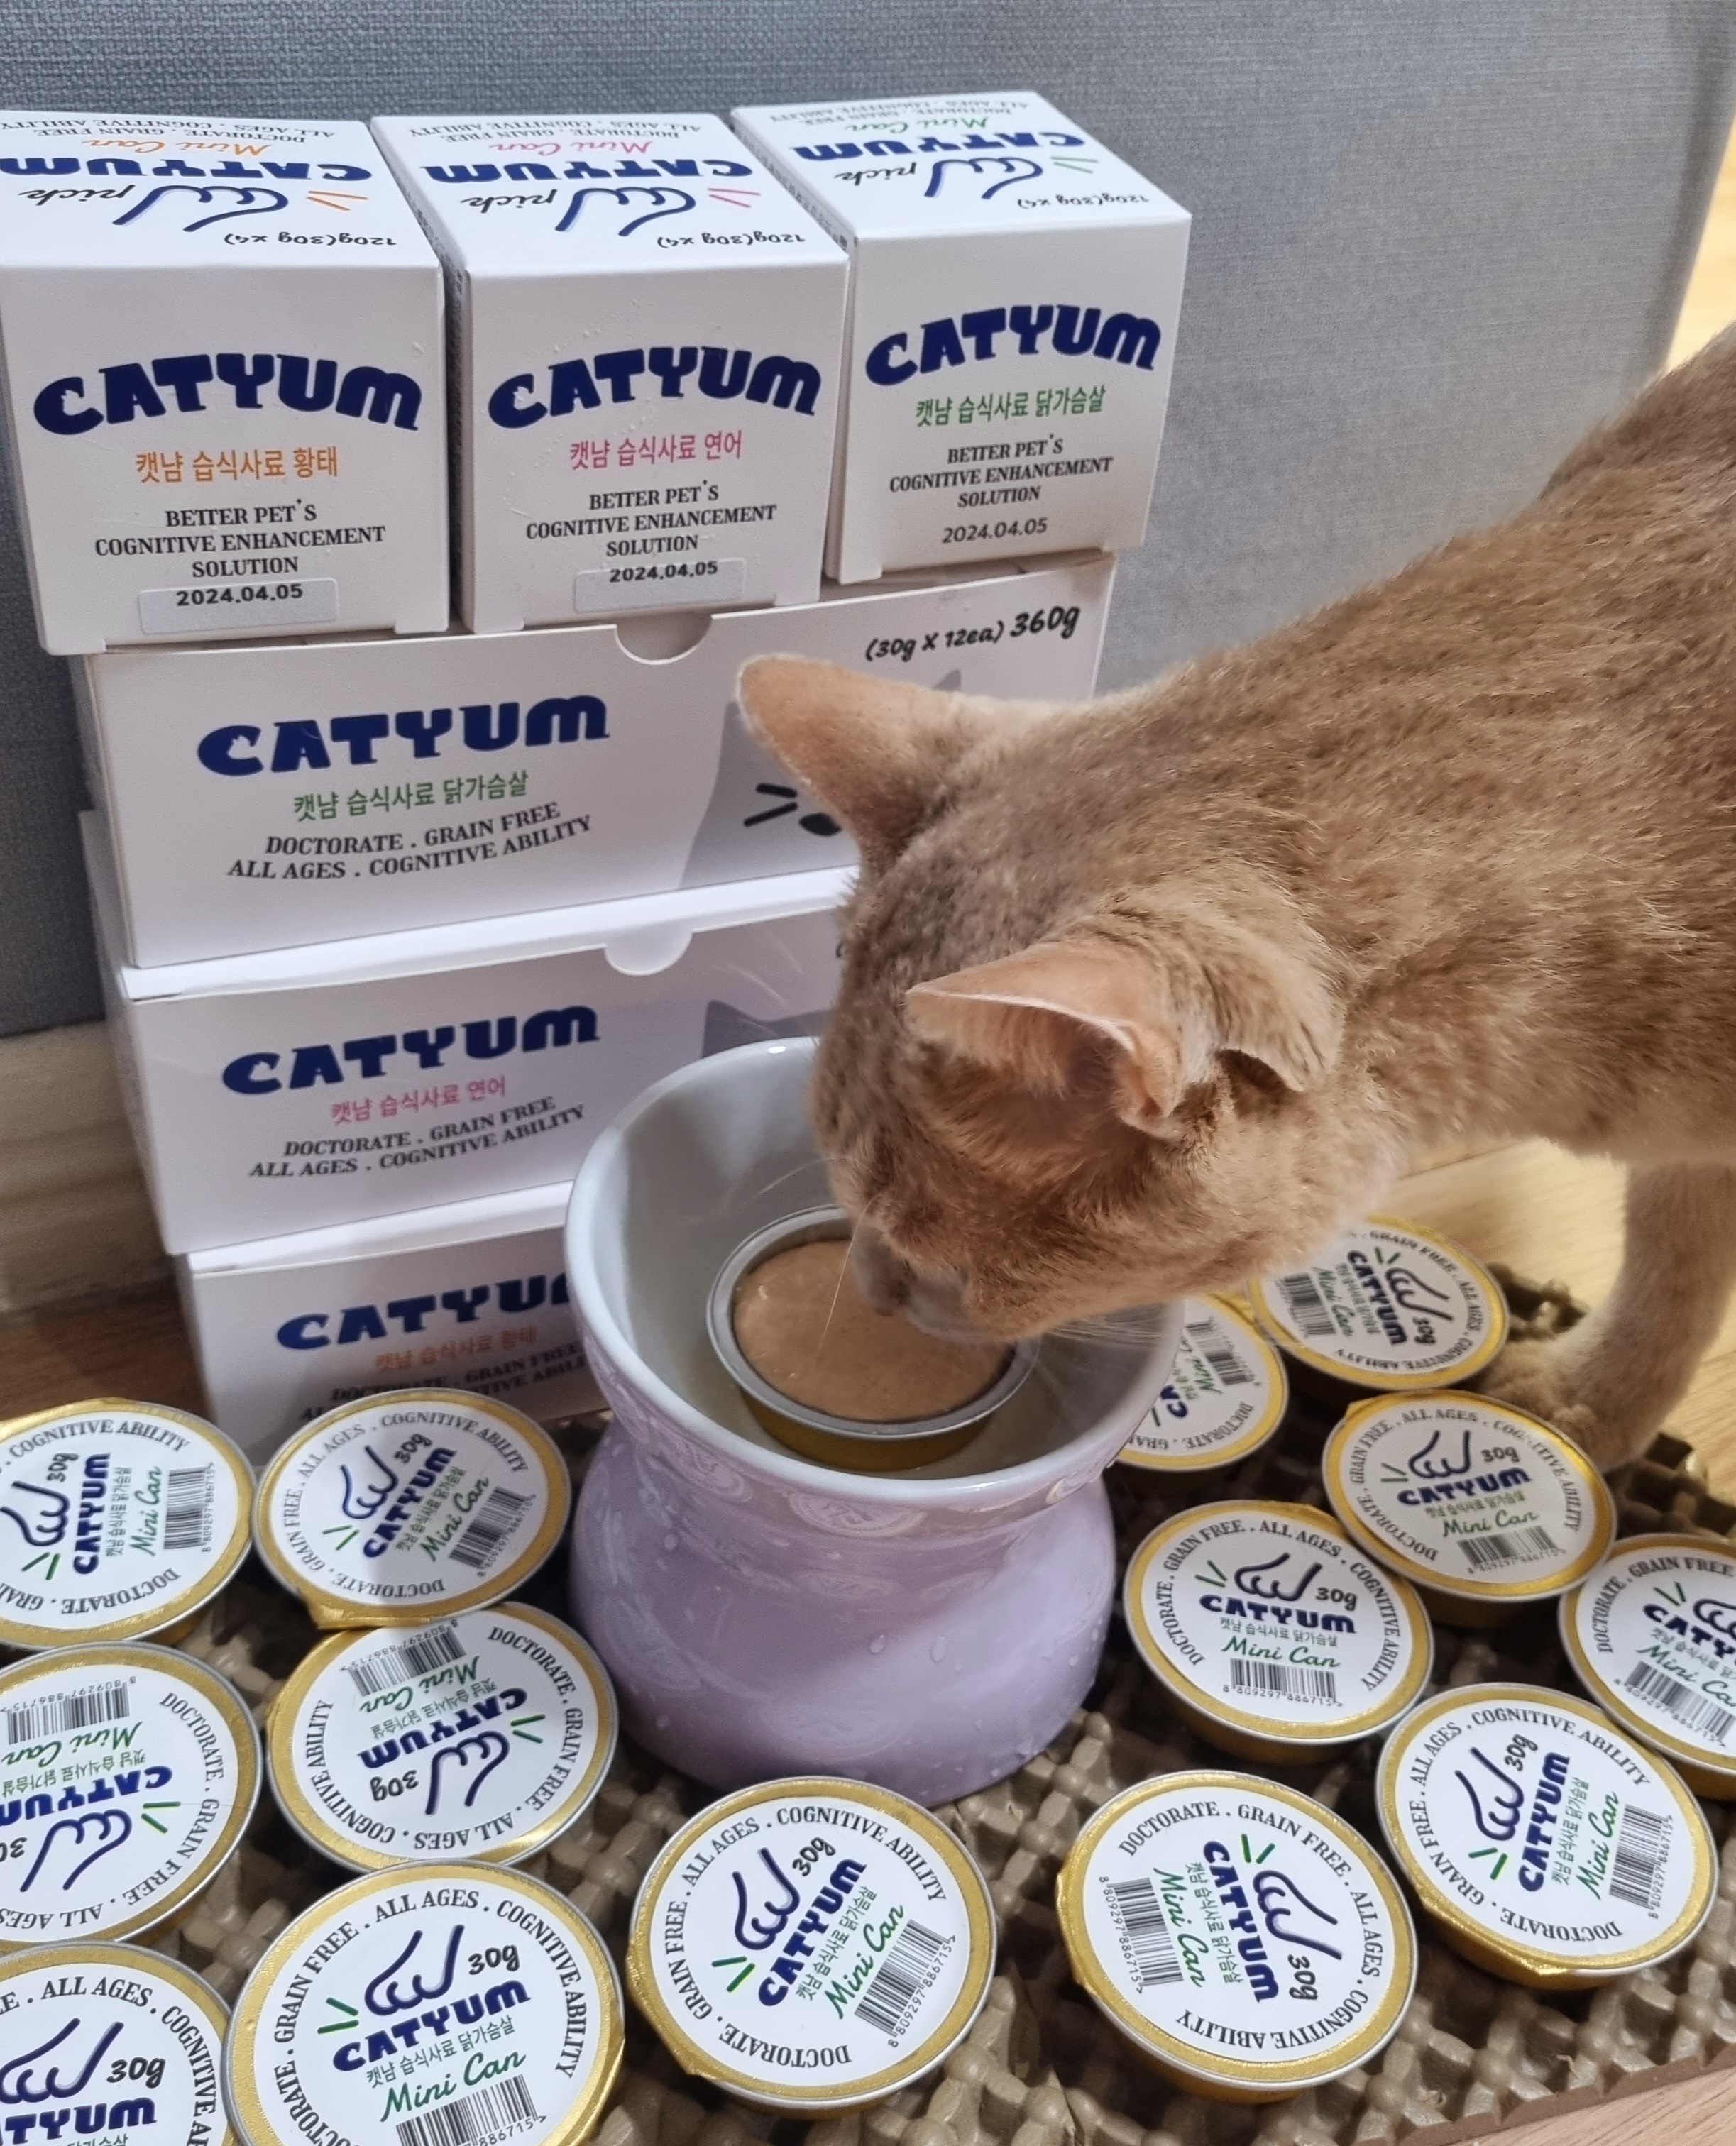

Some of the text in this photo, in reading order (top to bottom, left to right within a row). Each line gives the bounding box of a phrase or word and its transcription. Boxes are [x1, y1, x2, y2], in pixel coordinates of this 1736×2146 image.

[1, 119, 335, 138] ALL AGES COGNITIVE ABILITY
[185, 129, 305, 143] DOCTORATE
[409, 123, 482, 137] ABILITY
[845, 116, 989, 133] Mini Can
[82, 139, 272, 156] Mini Can
[488, 141, 653, 155] Mini Can
[789, 131, 1085, 161] CATYUM
[0, 158, 371, 181] CATYUM
[419, 160, 753, 183] CATYUM
[18, 184, 136, 207] pick
[460, 189, 557, 214] pick
[865, 304, 1161, 386] CATYUM
[33, 353, 422, 436] CATYUM
[488, 346, 821, 429] CATYUM
[958, 392, 1029, 424] 습식사료
[1035, 385, 1106, 419] 닭가슴살
[136, 446, 338, 484] 캣냠 습식사료 황태
[617, 434, 696, 467] 습식사료
[704, 430, 742, 460] 연어
[947, 443, 1011, 465] BETTER
[889, 456, 1114, 493] COGNITIVE ENHANCEMENT
[588, 490, 661, 510] BETTER
[957, 485, 1041, 508] SOLUTION
[165, 507, 249, 527] BETTER
[526, 504, 777, 539] COGNITIVE ENHANCEMENT
[942, 517, 1048, 544] 2024.04.05
[95, 526, 385, 556] COGNITIVE ENHANCEMENT
[606, 534, 699, 557] SOLUTION
[192, 556, 299, 578] SOLUTION
[610, 561, 718, 583] 2024.04.05
[177, 583, 303, 607] 2024.04.05
[865, 639, 916, 663] (30g
[945, 621, 1004, 649] 12ea)
[1010, 607, 1080, 639] 360g
[197, 695, 610, 776] CATYUM
[348, 783, 435, 816] 습식사료
[443, 770, 529, 805] 닭가슴살
[228, 815, 592, 880] ALL AGES COGNITIVE ABILITY
[265, 802, 560, 855] DOCTORATE GRAIN FREE
[222, 1005, 600, 1094] CATYUM
[380, 1084, 460, 1117] 습식사료
[468, 1075, 507, 1102] 연어
[250, 1104, 586, 1177] ALL AGES COGNITIVE ABILITY
[284, 1096, 556, 1157] DOCTORATE GRAIN FREE
[1348, 1250, 1407, 1346] CATYUM
[9, 1419, 190, 1458] COGNITIVE ABILITY
[394, 1433, 434, 1465] 30g
[1481, 1446, 1520, 1464] 30g
[47, 1453, 79, 1482] 30g
[1397, 1467, 1532, 1505] CATYUM
[73, 1452, 111, 1575] CATYUM
[129, 1466, 163, 1556] Mini Can
[363, 1446, 458, 1558] CATYUM
[420, 1476, 490, 1563] Mini Can
[1443, 1509, 1538, 1538] Mini Can
[1199, 1595, 1356, 1634] CATYUM
[1316, 1587, 1358, 1612] 30g
[1156, 1581, 1205, 1666] DOCTORATE
[1221, 1636, 1340, 1668] Mini Can
[1636, 1645, 1698, 1683] Mini
[360, 1655, 480, 1714] Mini Can
[1, 1721, 143, 1768] Mini Can
[357, 1688, 528, 1770] CATYUM
[1471, 1707, 1576, 1735] COGNITIVE
[1578, 1729, 1651, 1785] ABILITY
[1504, 1734, 1539, 1772] 30g
[159, 1692, 224, 1860] DOCTORATE GRAIN
[370, 1769, 420, 1803] 30g
[1117, 1801, 1302, 1856] DOCTORATE GRAIN
[1518, 1751, 1570, 1892] CATYUM
[793, 1837, 837, 1876] 30g
[1576, 1791, 1620, 1900] Mini Can
[665, 1806, 947, 2068] DOCTORATE GRAIN FREE ALL AGES COGNITIVE ABILITY
[759, 1857, 867, 2007] CATYUM
[813, 1928, 850, 1974] 습식사료
[838, 1886, 877, 1932] 닭가슴살
[1153, 1867, 1209, 1988] Mini Can
[1202, 1841, 1279, 2003] CATYUM
[468, 1944, 521, 1975] 30g
[824, 1905, 903, 2019] Mini Can
[1287, 1954, 1317, 2001] 30g
[333, 1980, 532, 2071] CATYUM
[399, 2041, 457, 2075] 습식사료
[458, 2015, 515, 2052] 닭가슴살
[40, 1976, 216, 2117] ALL AGES COGNITIVE
[106, 2057, 165, 2089] 30g
[380, 2046, 526, 2122] Mini Can
